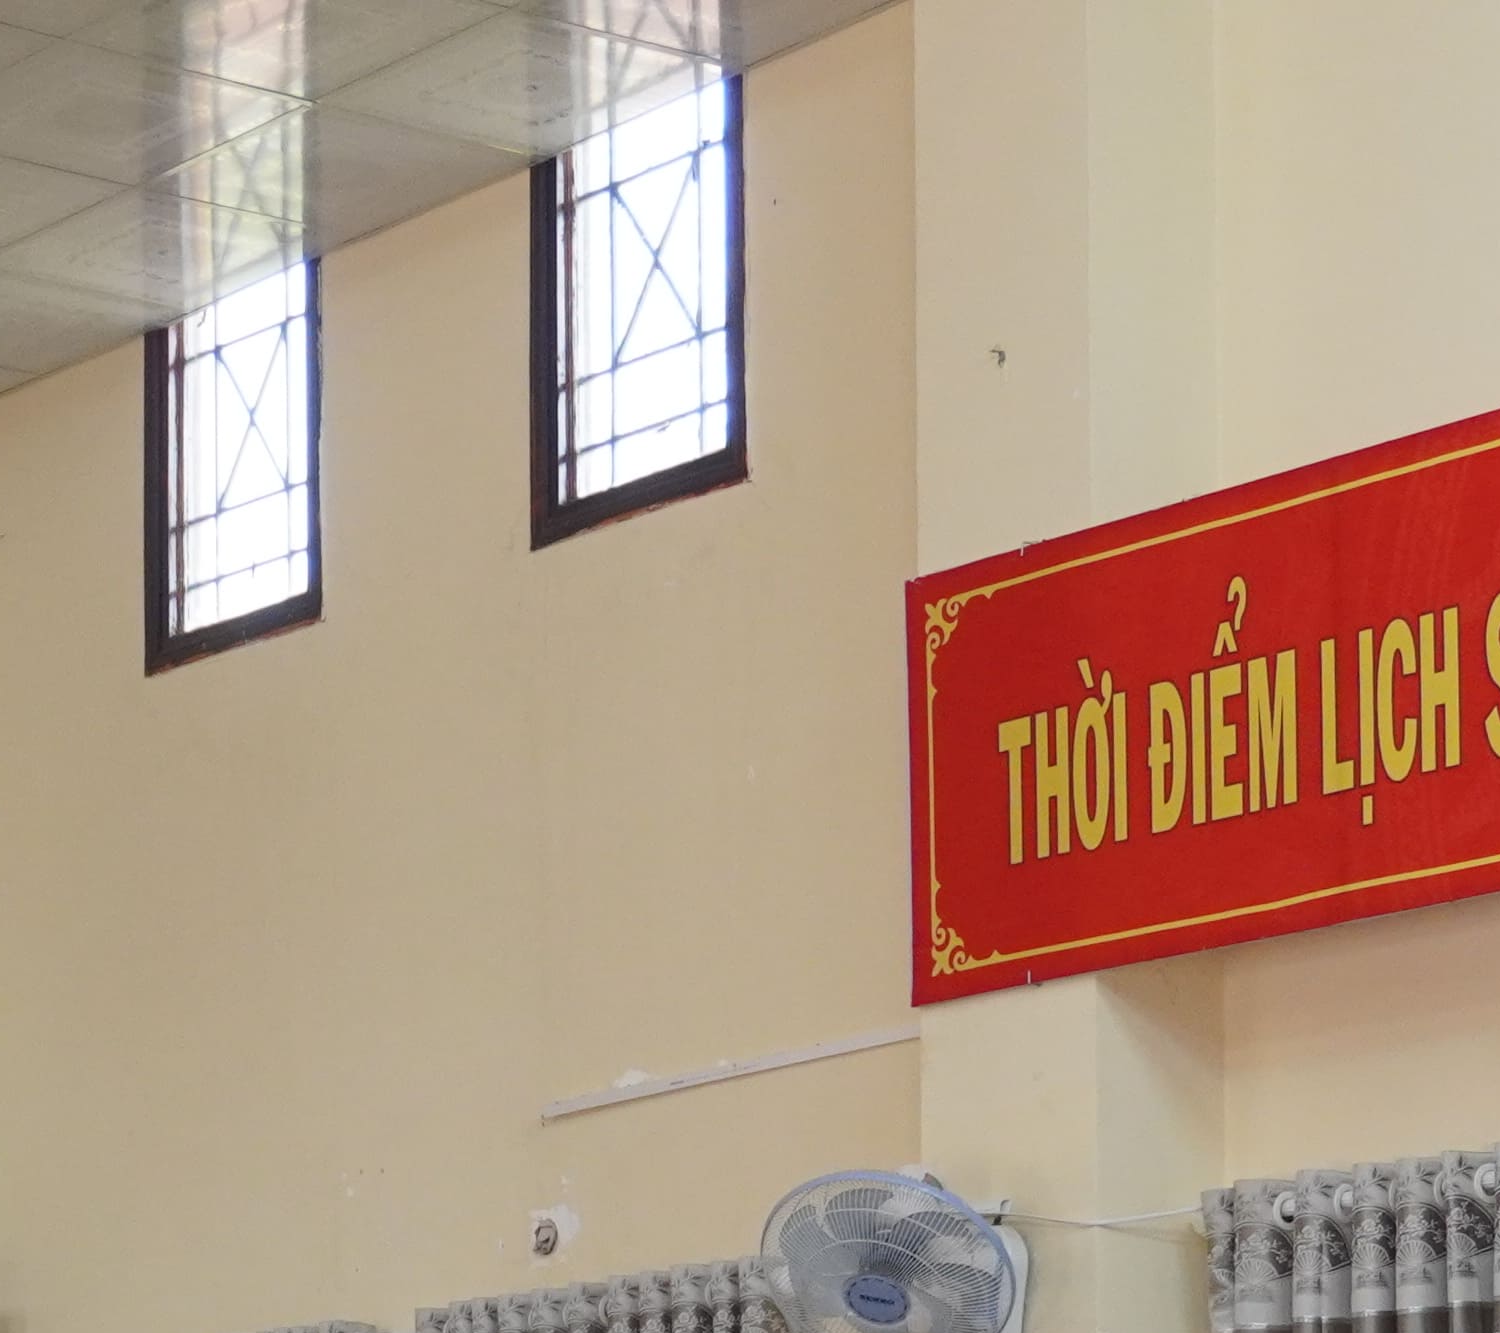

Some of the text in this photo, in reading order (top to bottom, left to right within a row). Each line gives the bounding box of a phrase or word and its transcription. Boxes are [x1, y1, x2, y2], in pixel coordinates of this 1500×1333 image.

[998, 658, 1128, 864] THỜI
[1148, 577, 1298, 833] ĐIỂM
[1320, 607, 1460, 826] LỊCH
